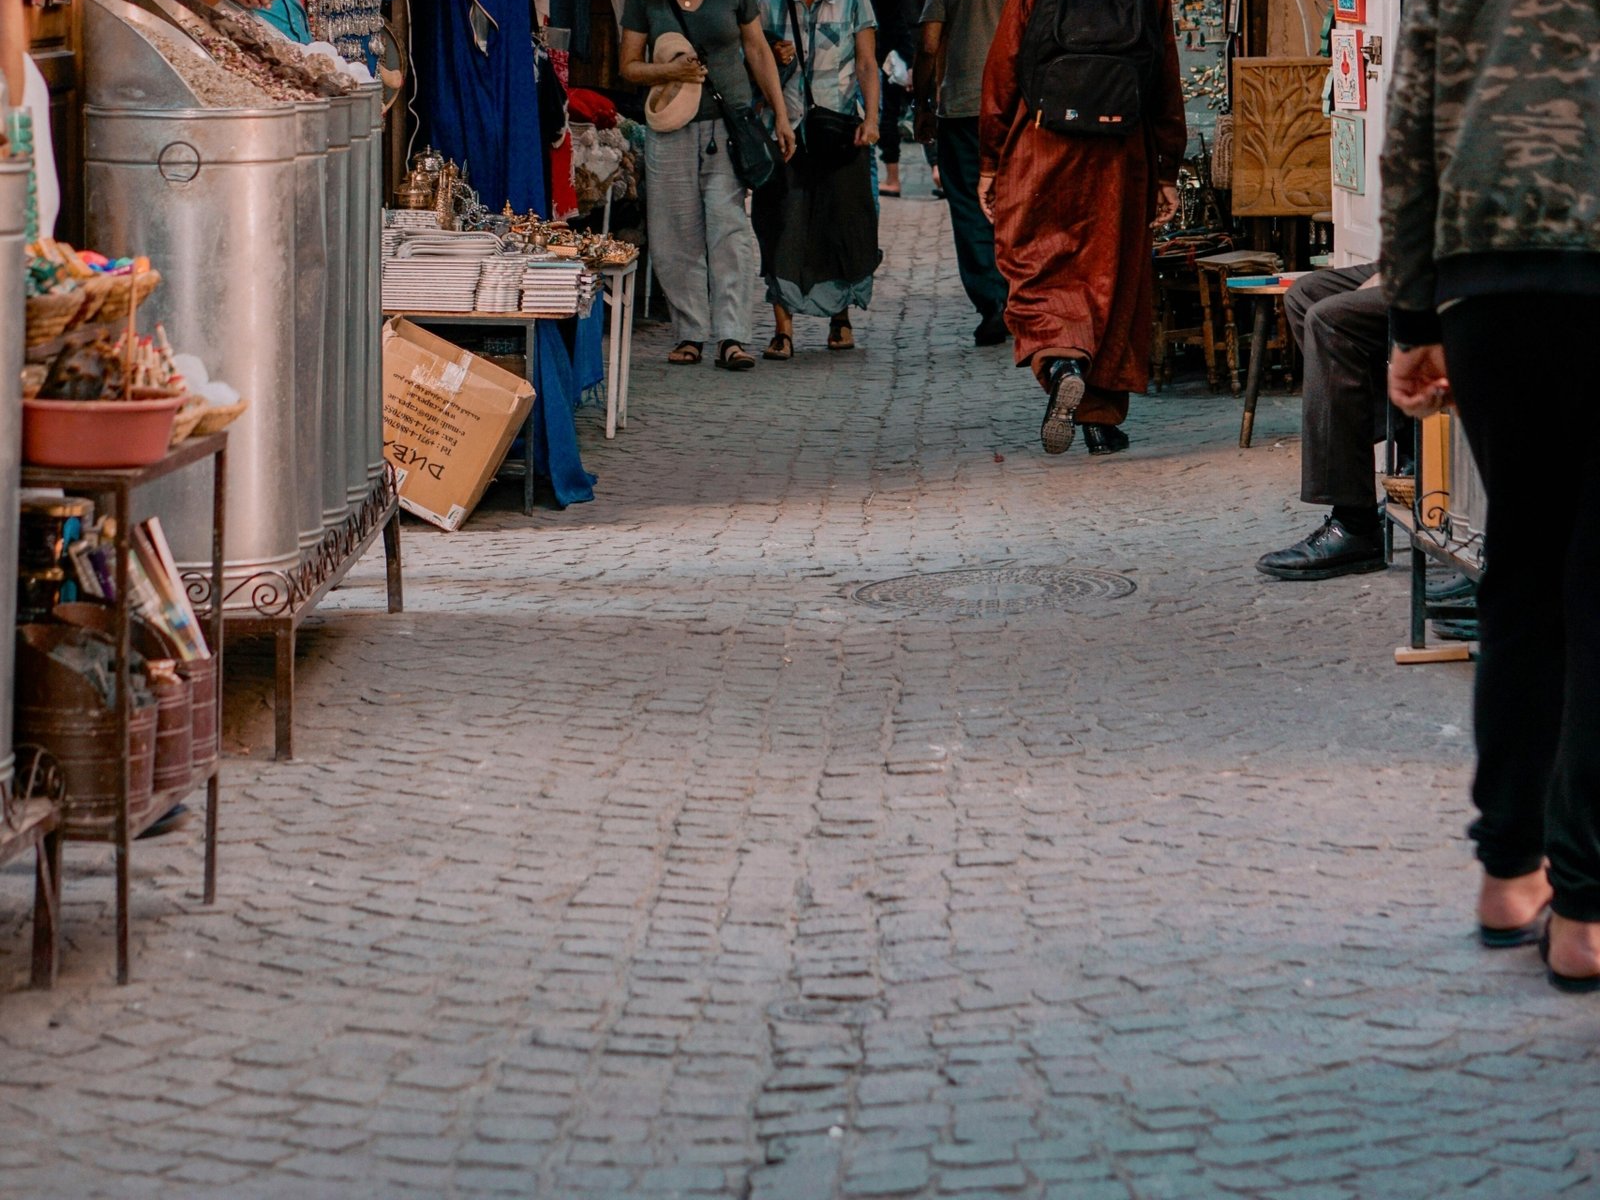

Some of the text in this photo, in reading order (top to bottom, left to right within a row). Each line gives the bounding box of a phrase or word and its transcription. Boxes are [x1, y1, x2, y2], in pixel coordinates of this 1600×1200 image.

[384, 415, 435, 445] +971-4-886706
[442, 433, 458, 446] Fax:
[441, 445, 452, 456] Tel
